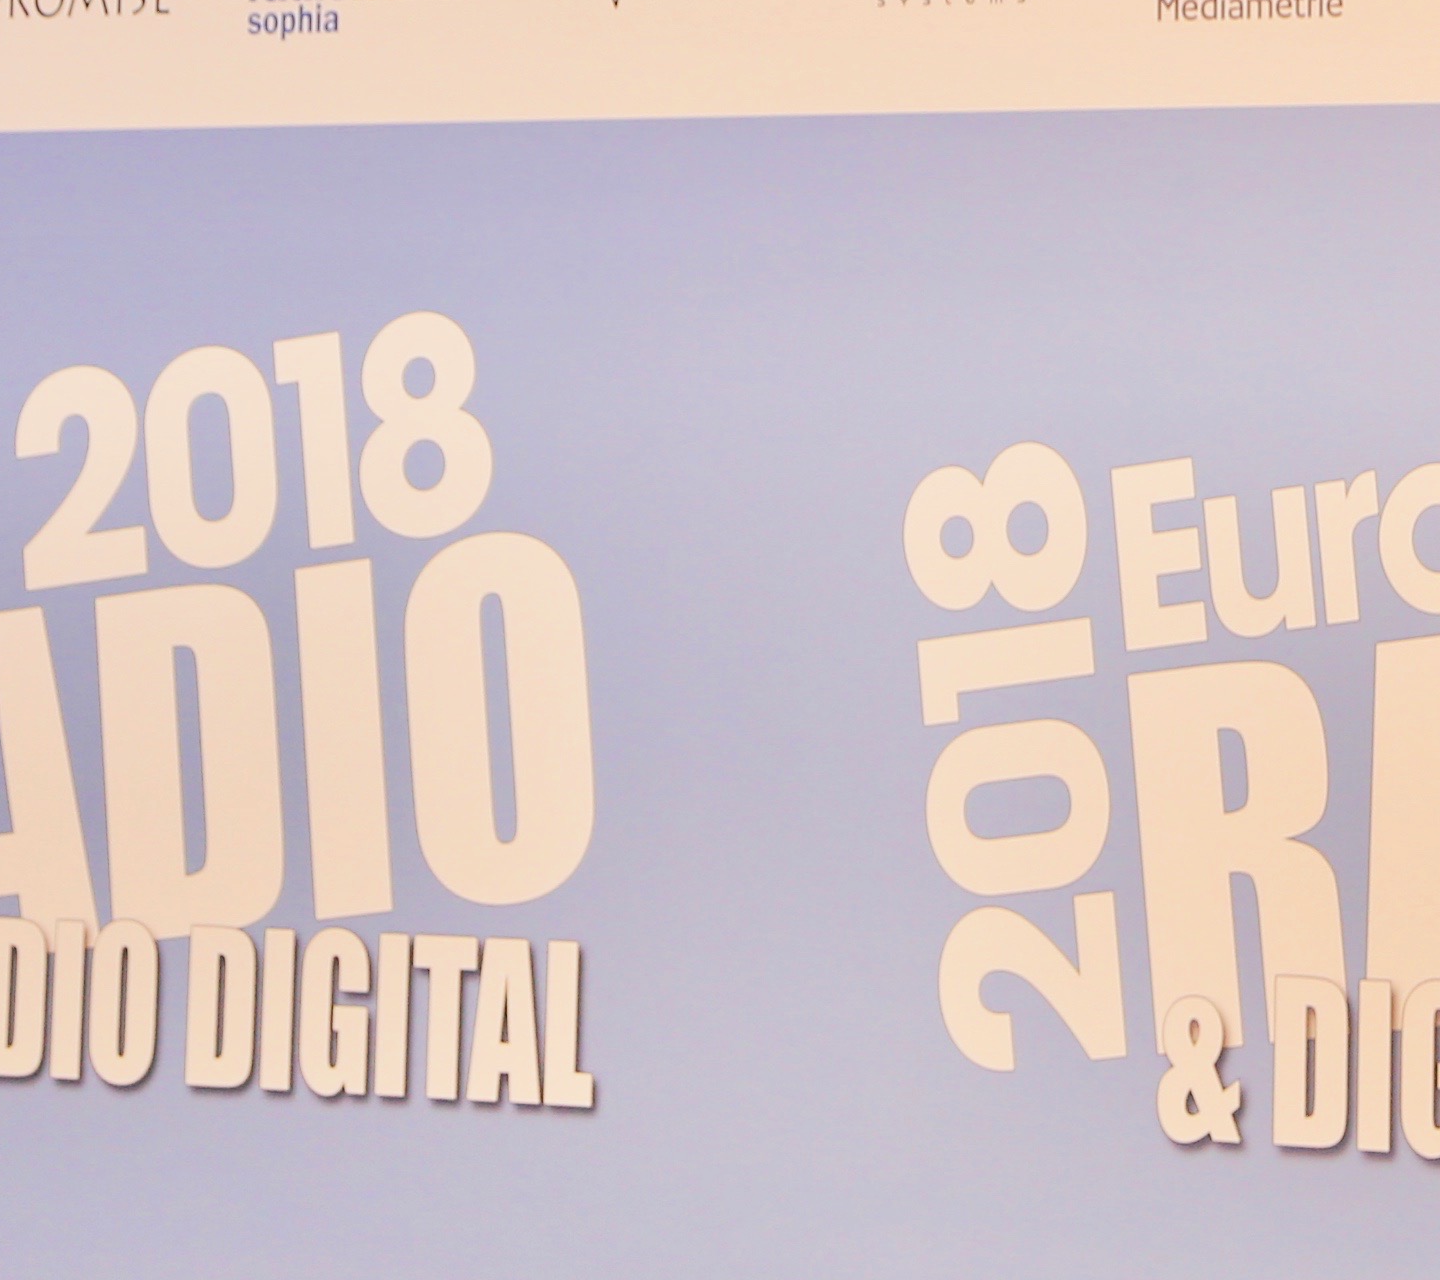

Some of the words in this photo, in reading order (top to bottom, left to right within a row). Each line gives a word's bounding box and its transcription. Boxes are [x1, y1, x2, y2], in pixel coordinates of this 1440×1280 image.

[248, 2, 339, 38] sophia
[14, 311, 494, 590] 2018
[902, 440, 1128, 1072] 2018
[184, 924, 596, 1108] DIGITAL
[1156, 994, 1241, 1144] &
